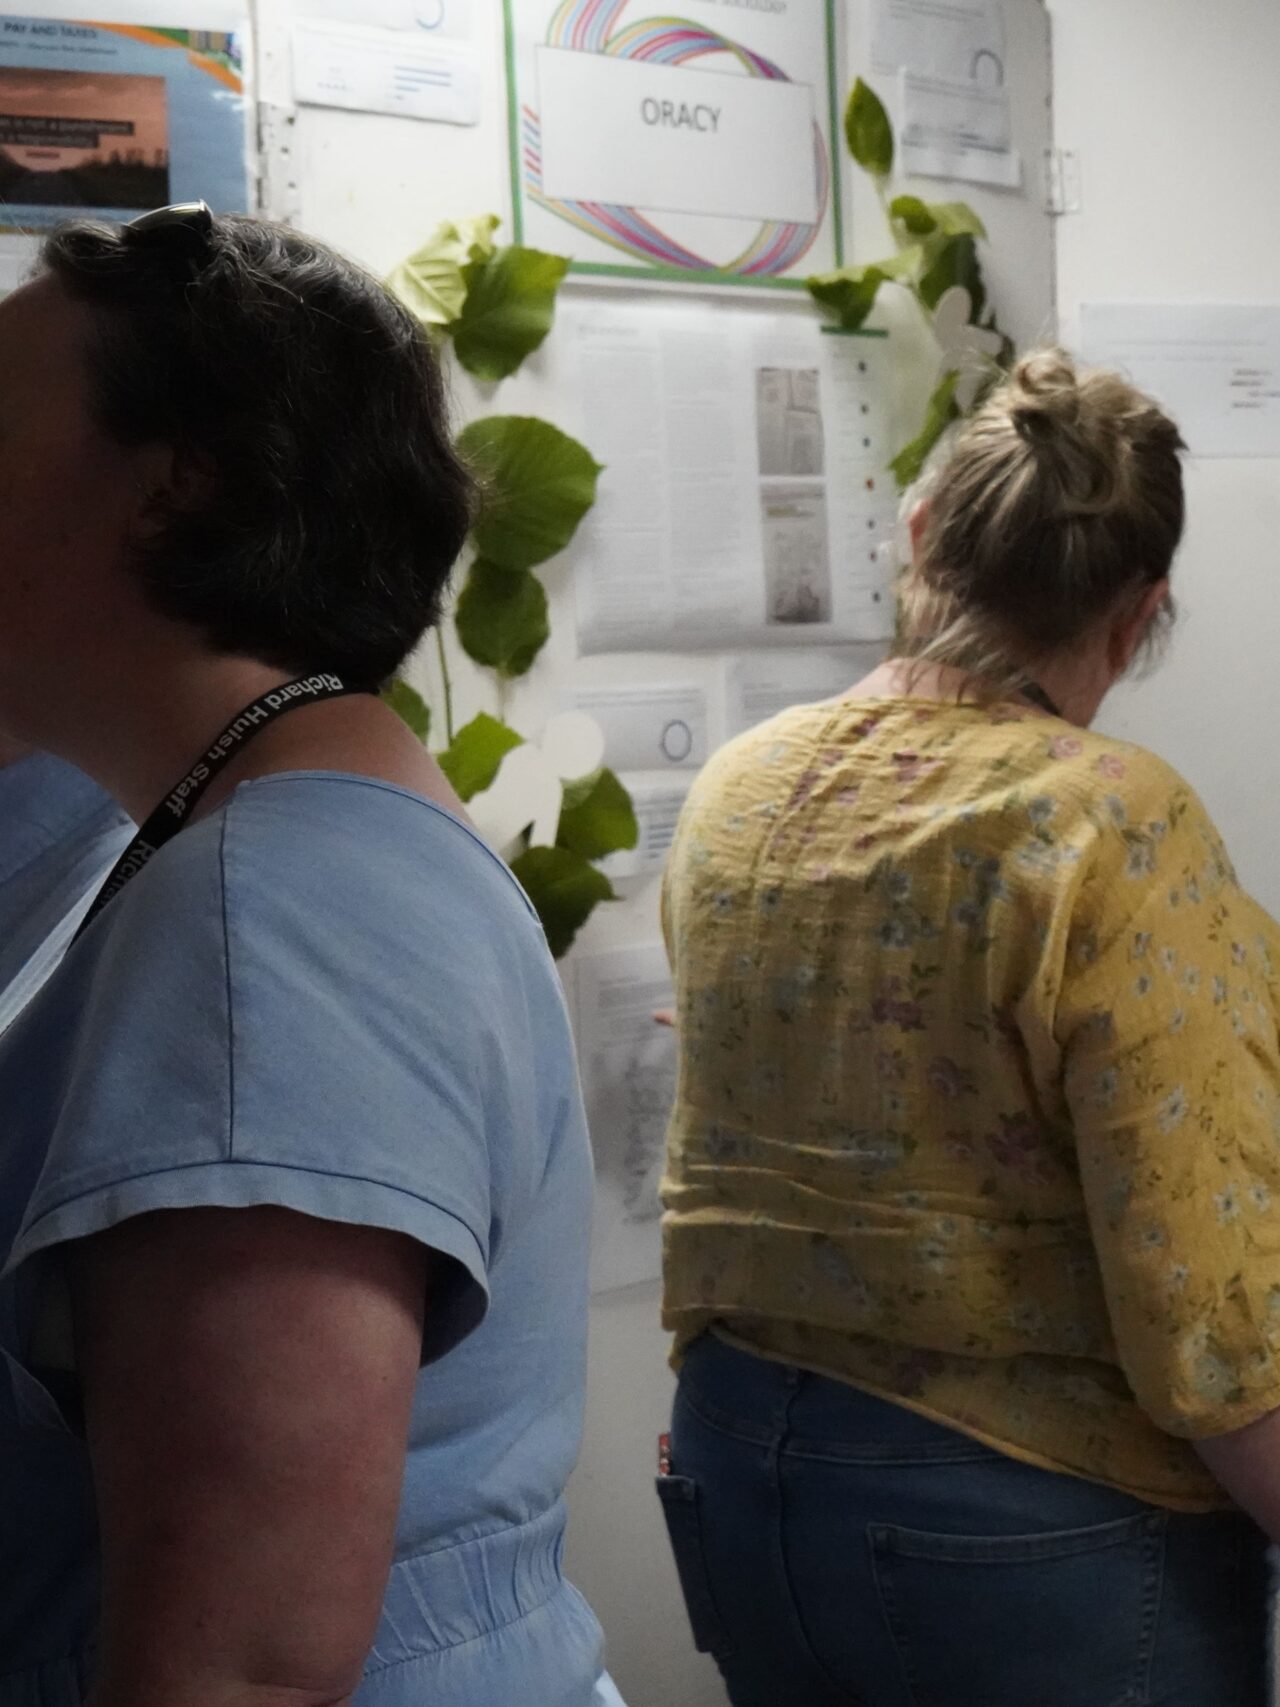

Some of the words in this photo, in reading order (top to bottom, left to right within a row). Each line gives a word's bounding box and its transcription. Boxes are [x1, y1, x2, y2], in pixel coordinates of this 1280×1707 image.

[641, 97, 721, 133] ORACY
[264, 672, 344, 709] Richard
[208, 705, 269, 760] Huish
[165, 763, 210, 818] Staff
